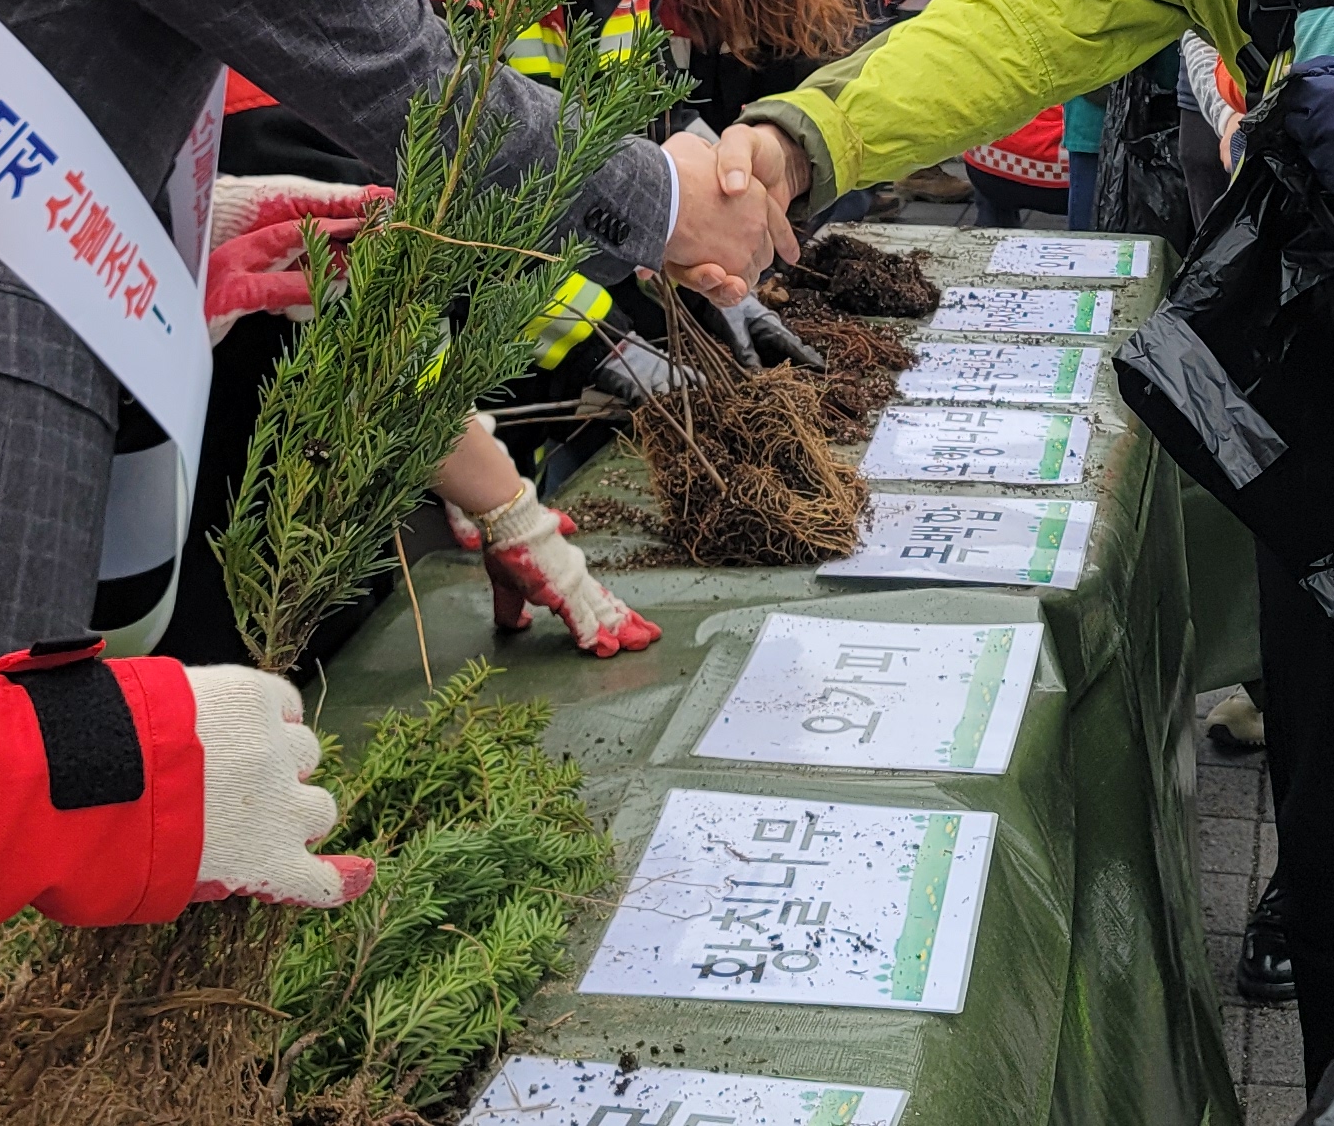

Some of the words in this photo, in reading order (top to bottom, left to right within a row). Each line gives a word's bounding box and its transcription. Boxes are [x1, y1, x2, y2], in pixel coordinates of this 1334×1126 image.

[45, 169, 173, 335] 산불조심!
[952, 347, 1019, 395] 오동나무
[920, 411, 1005, 476] 은행나무
[900, 506, 1003, 564] 목백합
[801, 643, 921, 743] 오가피
[697, 814, 841, 983] 황칠나무
